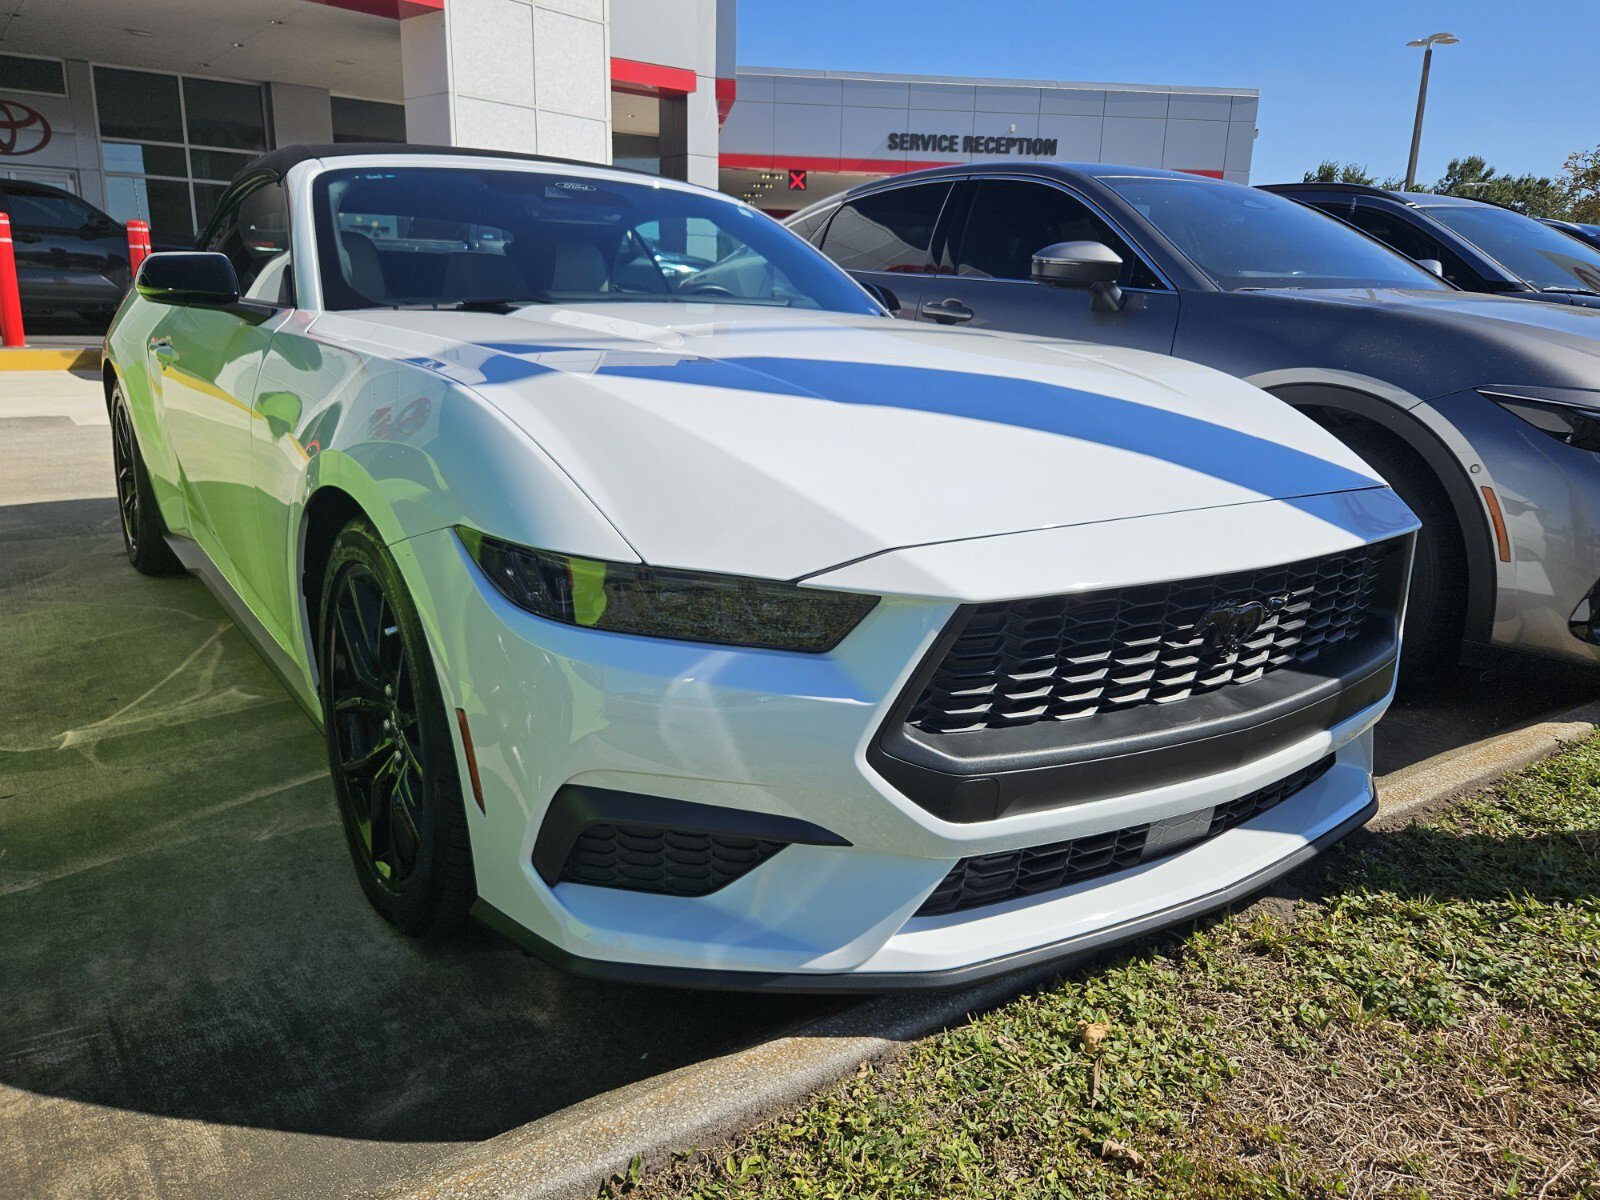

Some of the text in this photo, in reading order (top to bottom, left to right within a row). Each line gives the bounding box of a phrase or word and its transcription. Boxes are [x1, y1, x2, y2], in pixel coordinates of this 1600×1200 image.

[888, 133, 1058, 156] SERVICE RECEPTION
[562, 182, 591, 191] Ford
